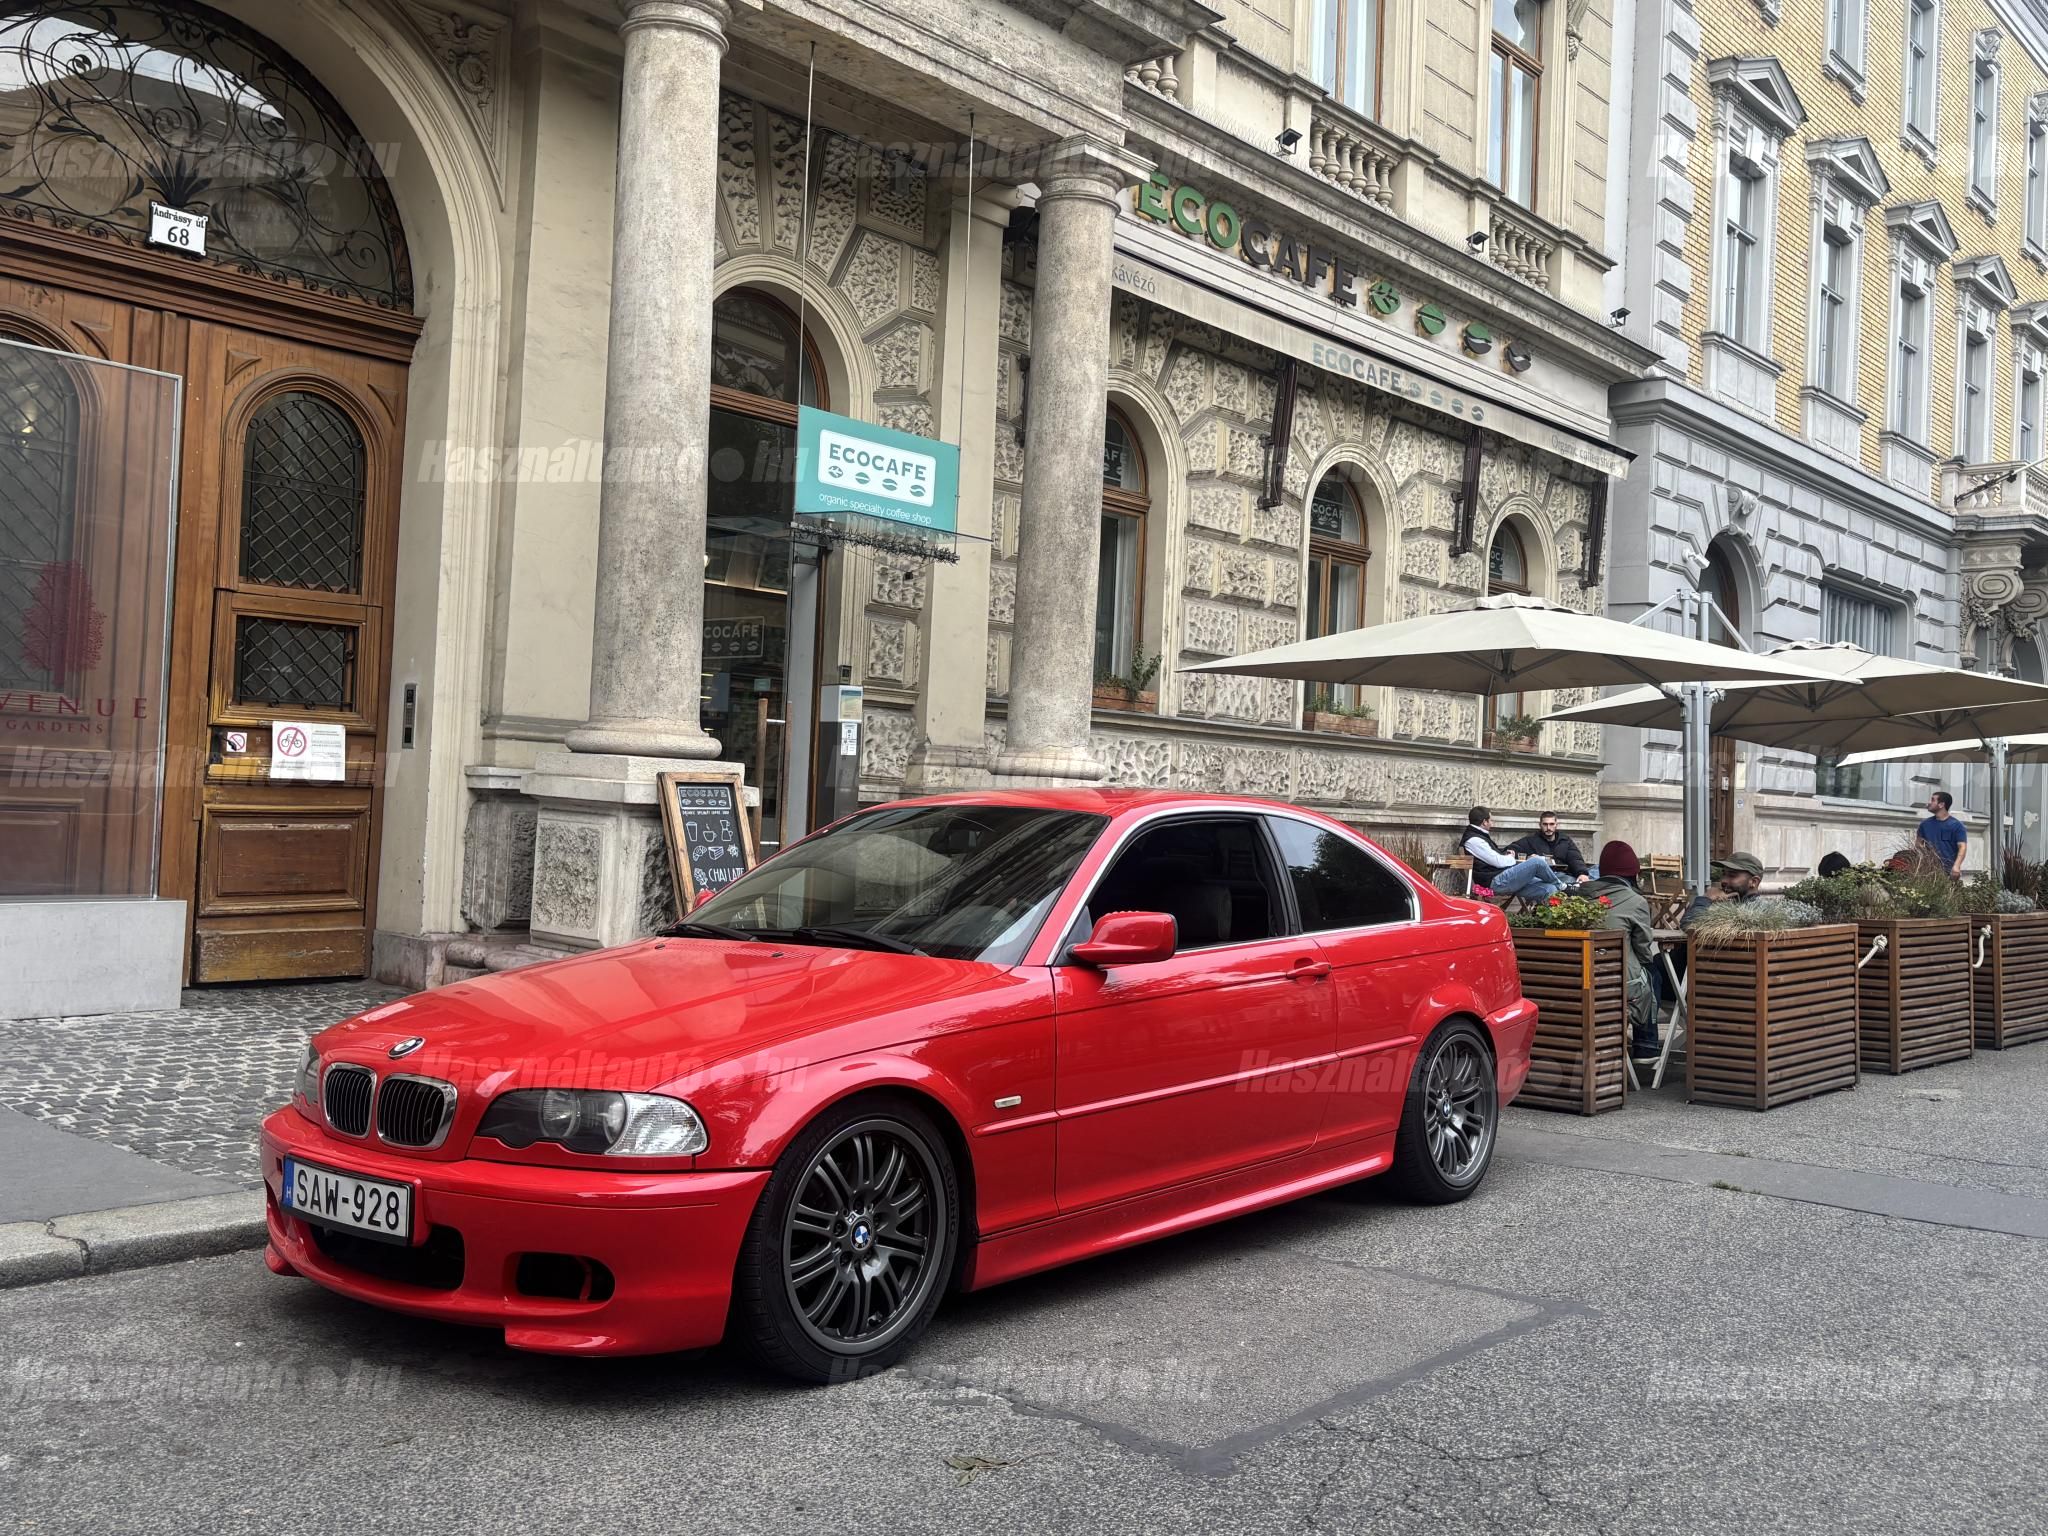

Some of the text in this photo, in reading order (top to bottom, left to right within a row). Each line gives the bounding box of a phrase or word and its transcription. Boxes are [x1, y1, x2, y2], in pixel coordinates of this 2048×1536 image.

[153, 206, 204, 228] Andrássy út
[168, 226, 189, 246] 68
[1138, 171, 1360, 306] ECOCAFE
[1312, 342, 1402, 393] ECOCAFE
[829, 443, 927, 481] ECOCAFE
[818, 493, 932, 525] organic specialty coffee shop
[6, 720, 103, 734] GARDENS
[286, 1186, 292, 1198] H
[297, 1169, 399, 1230] SAW-928
